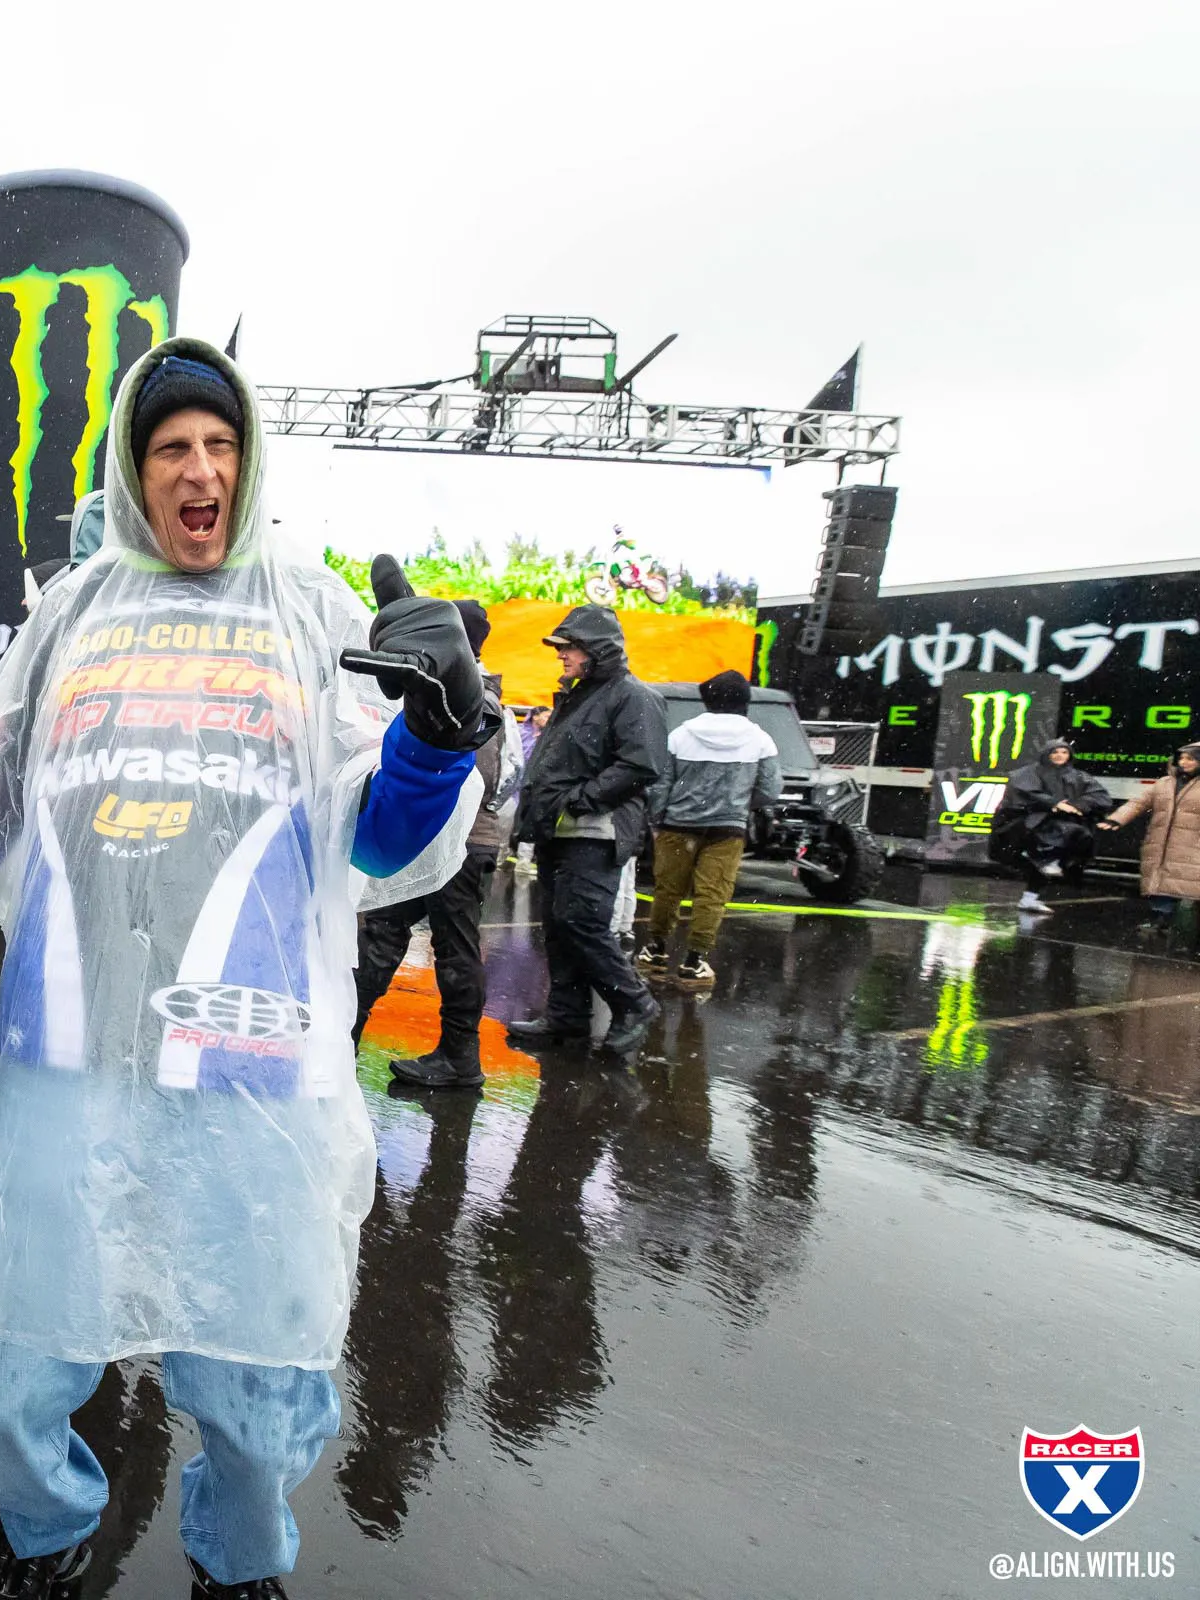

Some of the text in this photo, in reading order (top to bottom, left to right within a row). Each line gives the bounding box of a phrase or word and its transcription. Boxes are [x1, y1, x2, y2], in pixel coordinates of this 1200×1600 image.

[73, 622, 294, 656] 800-COLLEC
[92, 793, 194, 840] UFO
[101, 841, 171, 859] RACING
[167, 1027, 222, 1049] PRO
